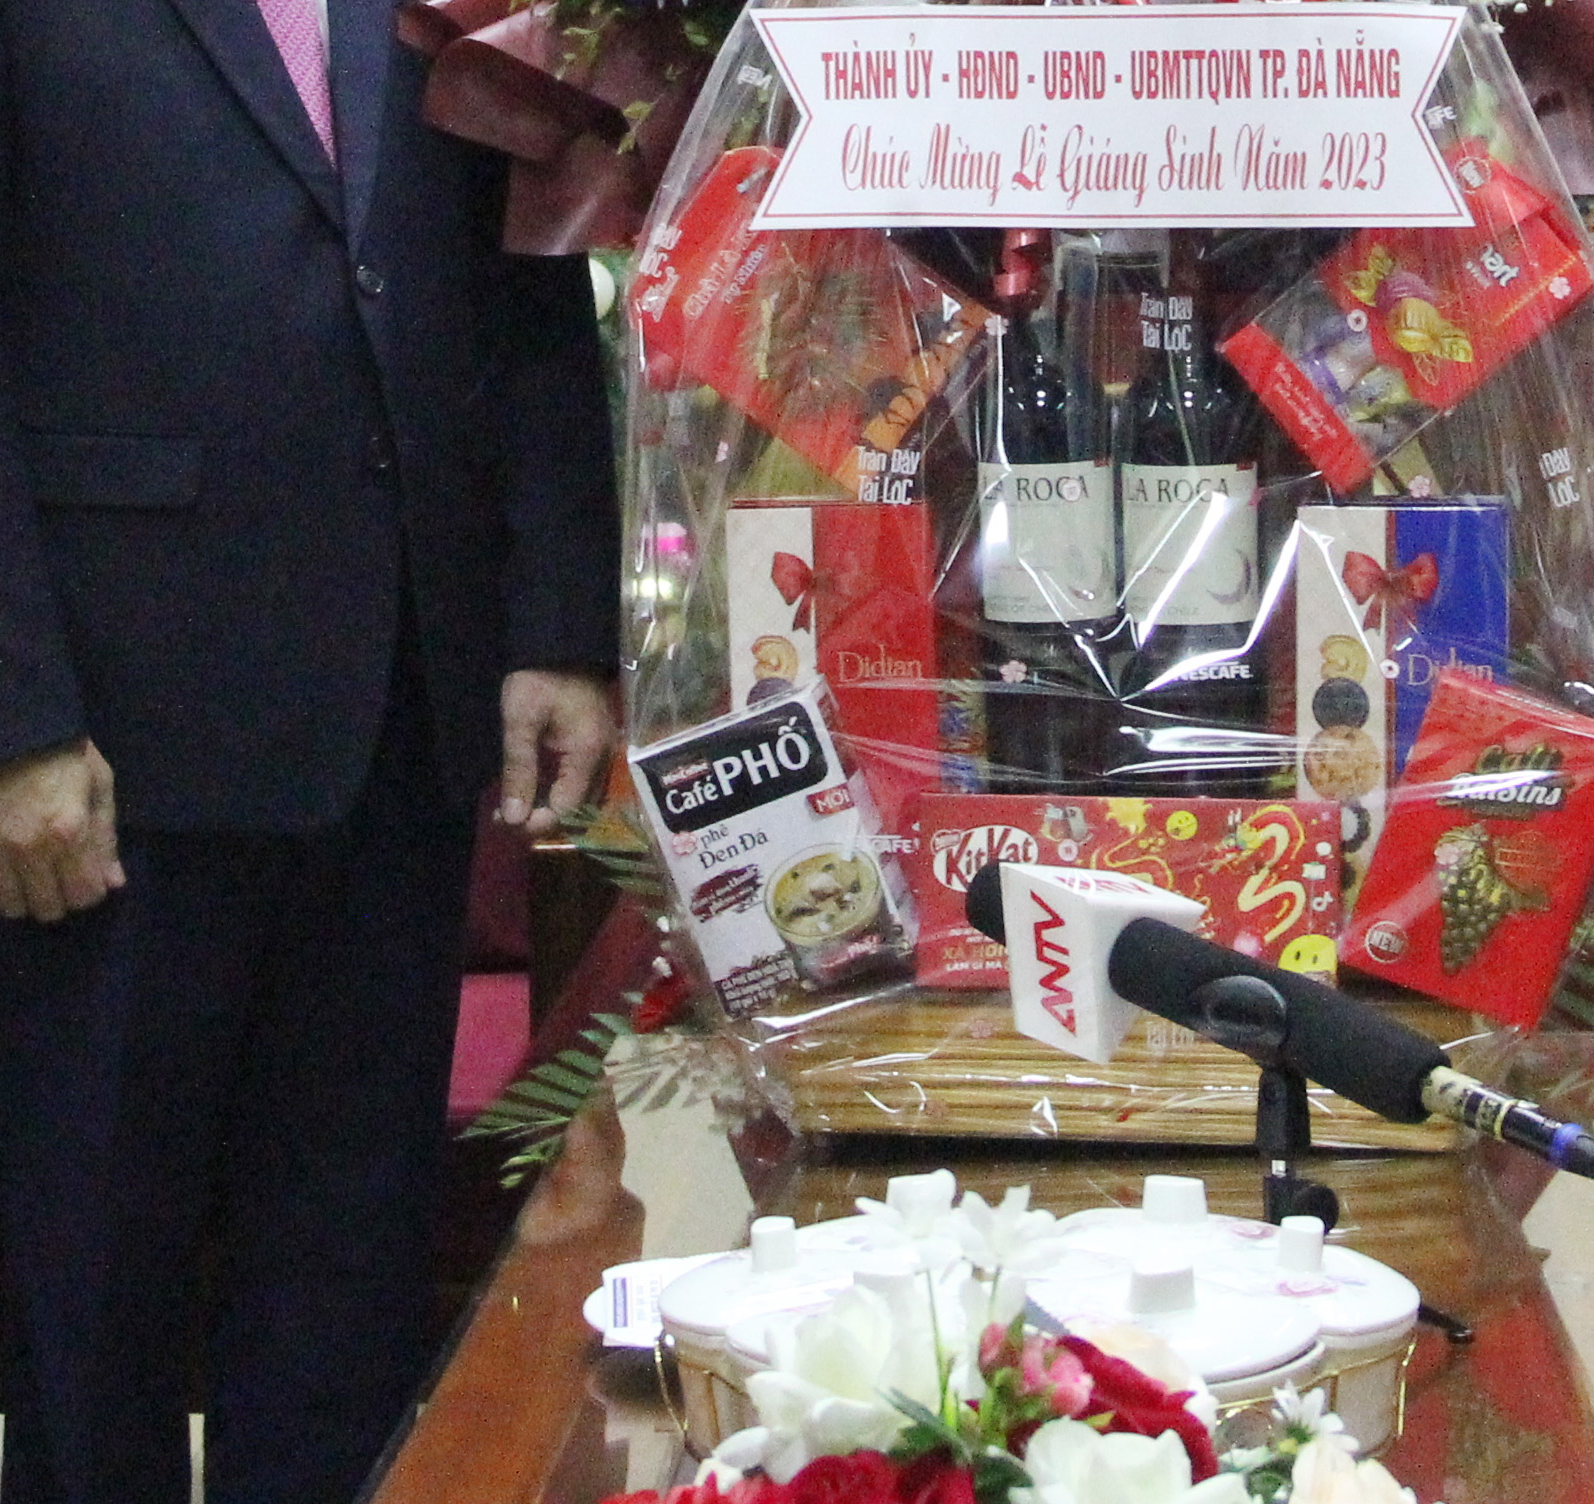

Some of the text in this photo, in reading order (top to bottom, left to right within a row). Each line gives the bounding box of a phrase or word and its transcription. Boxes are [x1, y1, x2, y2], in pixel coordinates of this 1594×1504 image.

[821, 40, 896, 100] THÀNH
[905, 32, 933, 99] ỦY
[957, 50, 1019, 100] HĐND
[1044, 50, 1106, 100] UBND
[1131, 49, 1252, 105] UBMTTQVN
[1259, 49, 1289, 98] TP.
[1297, 37, 1328, 98] ĐÀ
[1336, 29, 1400, 98] NẴNG
[841, 122, 1387, 211] Chúc Mừng Lễ Giáng Sinh Năm 2023
[666, 774, 719, 814] Café
[712, 716, 810, 796] PHỐ
[945, 827, 1034, 889] KitKat
